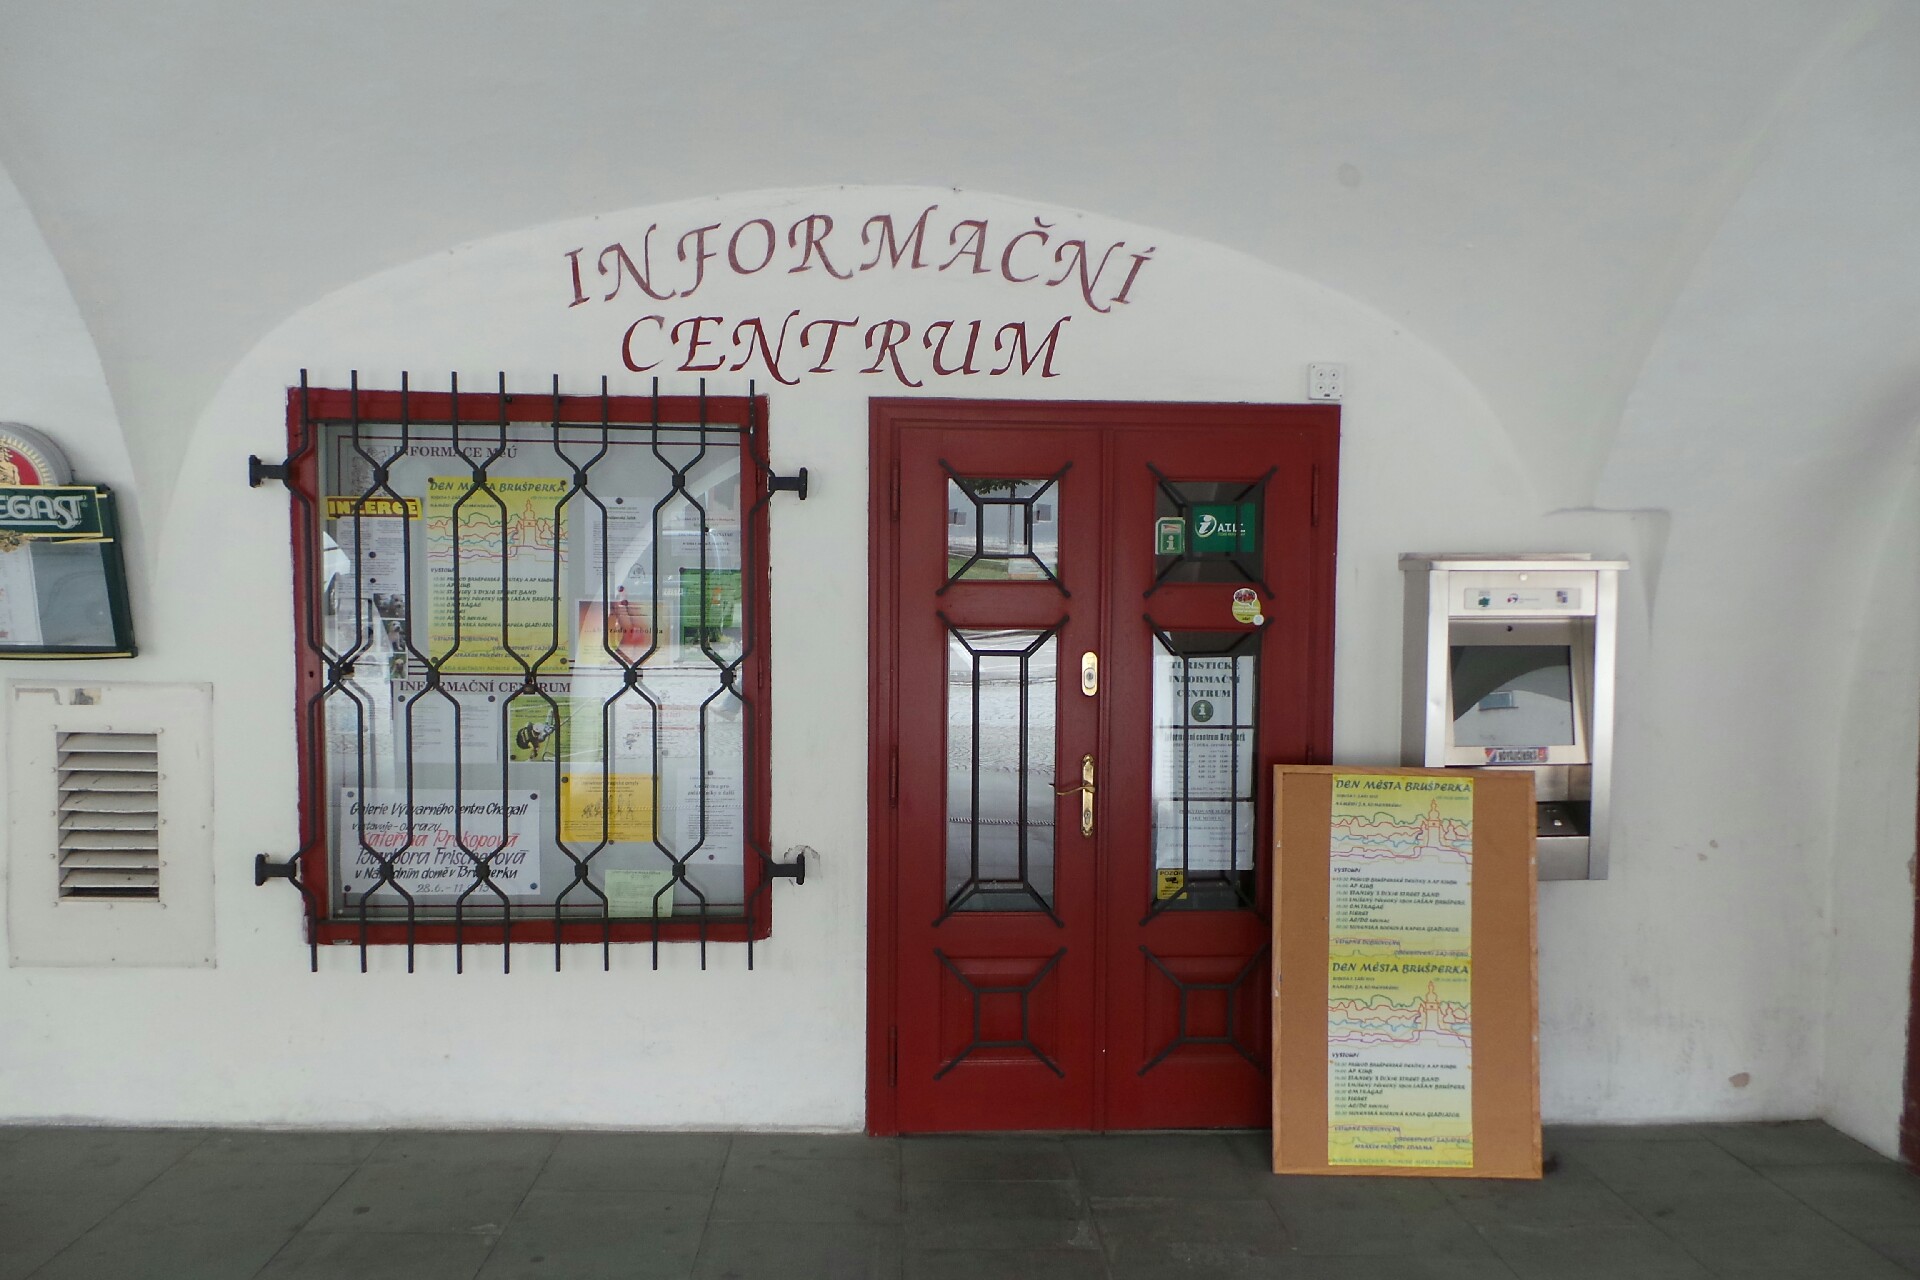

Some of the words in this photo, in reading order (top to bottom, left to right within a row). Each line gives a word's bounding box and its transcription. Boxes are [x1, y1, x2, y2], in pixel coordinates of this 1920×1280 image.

[564, 204, 1157, 312] INFORMAČNÍ
[621, 310, 1072, 388] CENTRUM
[430, 481, 453, 491] DEN
[400, 679, 494, 694] INFRMAČNÍ
[498, 680, 571, 693] CENRUM
[1176, 689, 1231, 698] CNTRUM
[1336, 780, 1361, 789] DEN
[390, 802, 455, 817] Vývarného
[456, 802, 485, 814] entra
[359, 831, 429, 847] ateřia
[364, 866, 420, 879] Nádním
[1332, 962, 1358, 972] DEN
